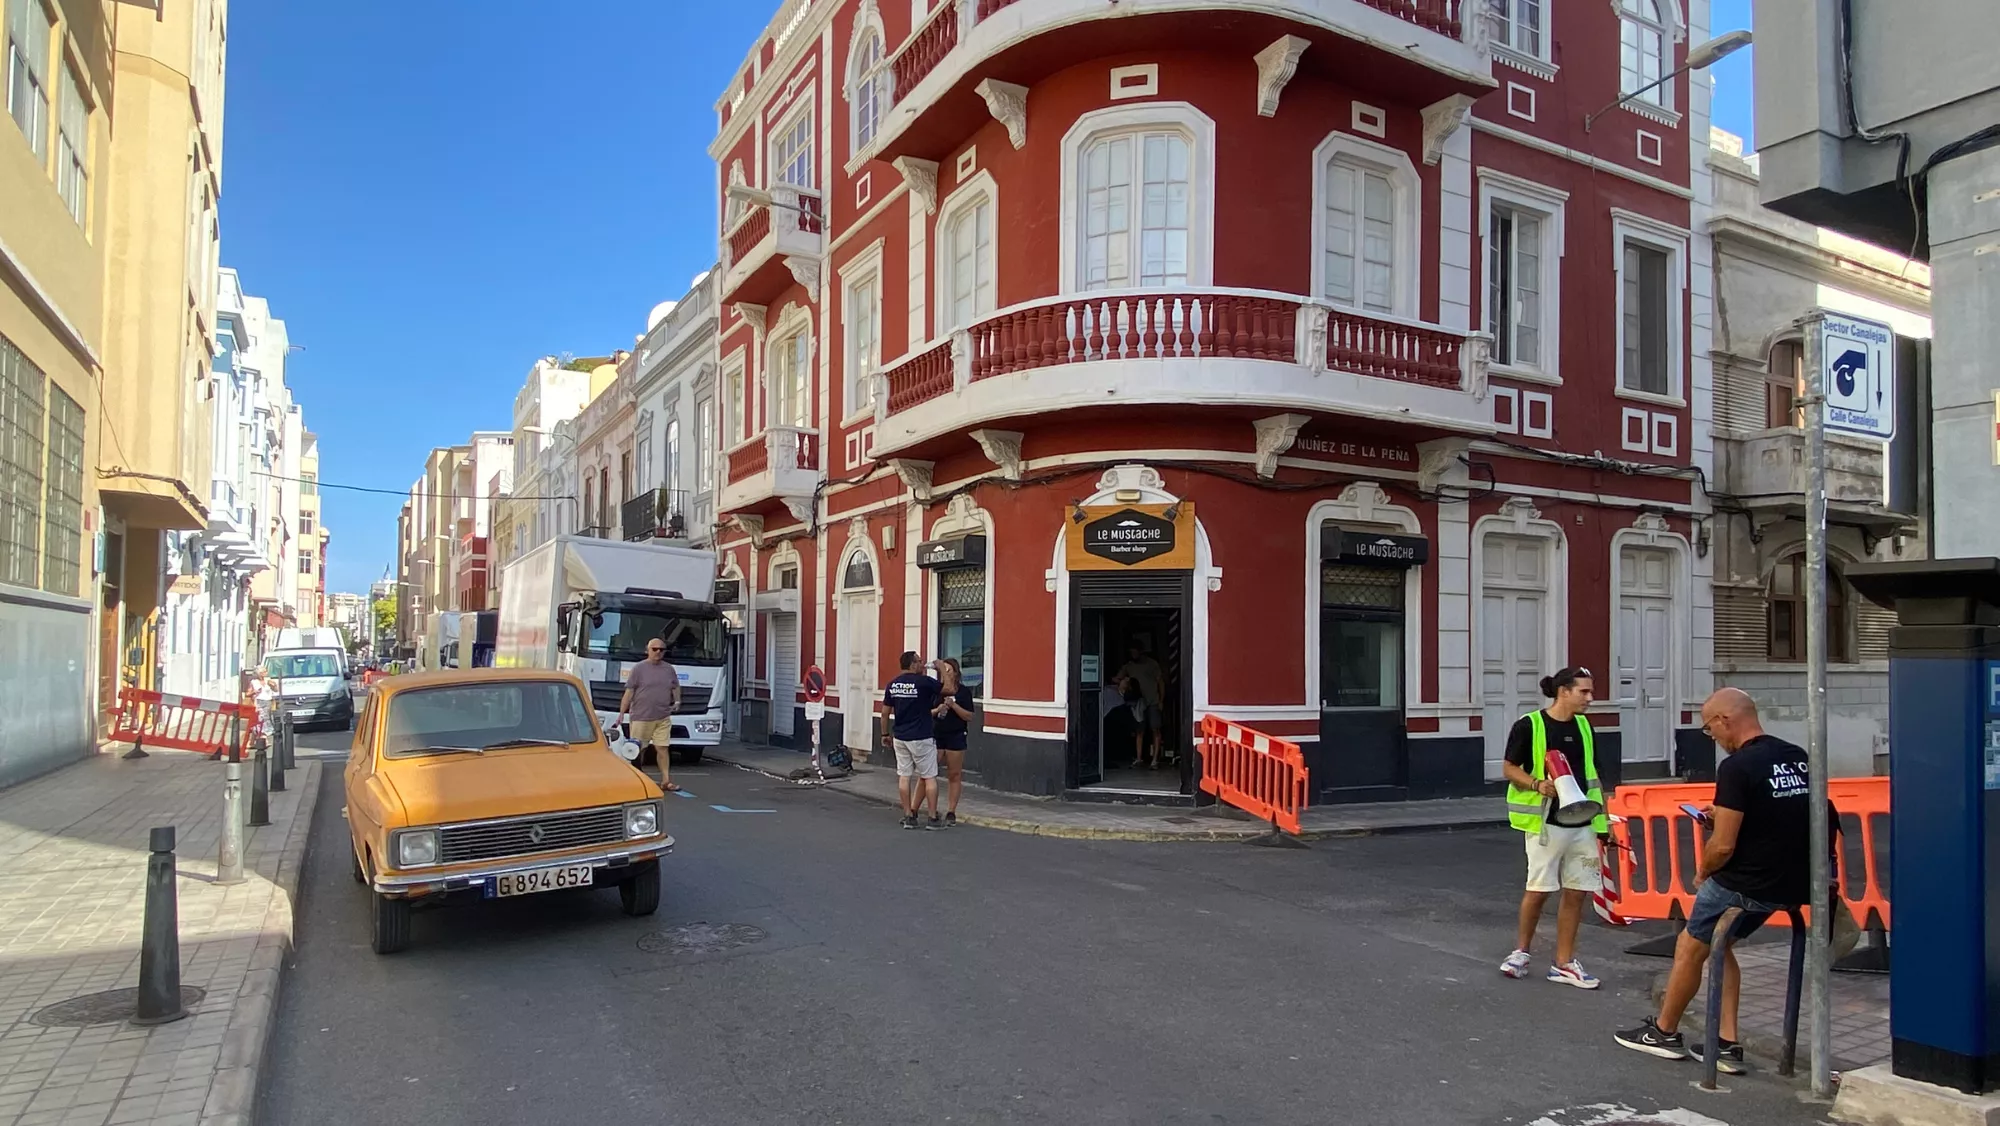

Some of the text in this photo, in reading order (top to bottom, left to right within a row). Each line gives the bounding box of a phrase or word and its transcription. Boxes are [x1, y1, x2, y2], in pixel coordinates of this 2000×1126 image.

[1823, 320, 1887, 344] Sector Canalejas
[1830, 408, 1879, 429] Calle Canalejas
[1341, 443, 1356, 455] DE
[1362, 446, 1377, 458] LA
[1381, 445, 1410, 462] PEÑA
[1111, 545, 1147, 553] Barber shop
[499, 876, 511, 895] G
[516, 871, 551, 892] 894
[556, 866, 590, 887] 652
